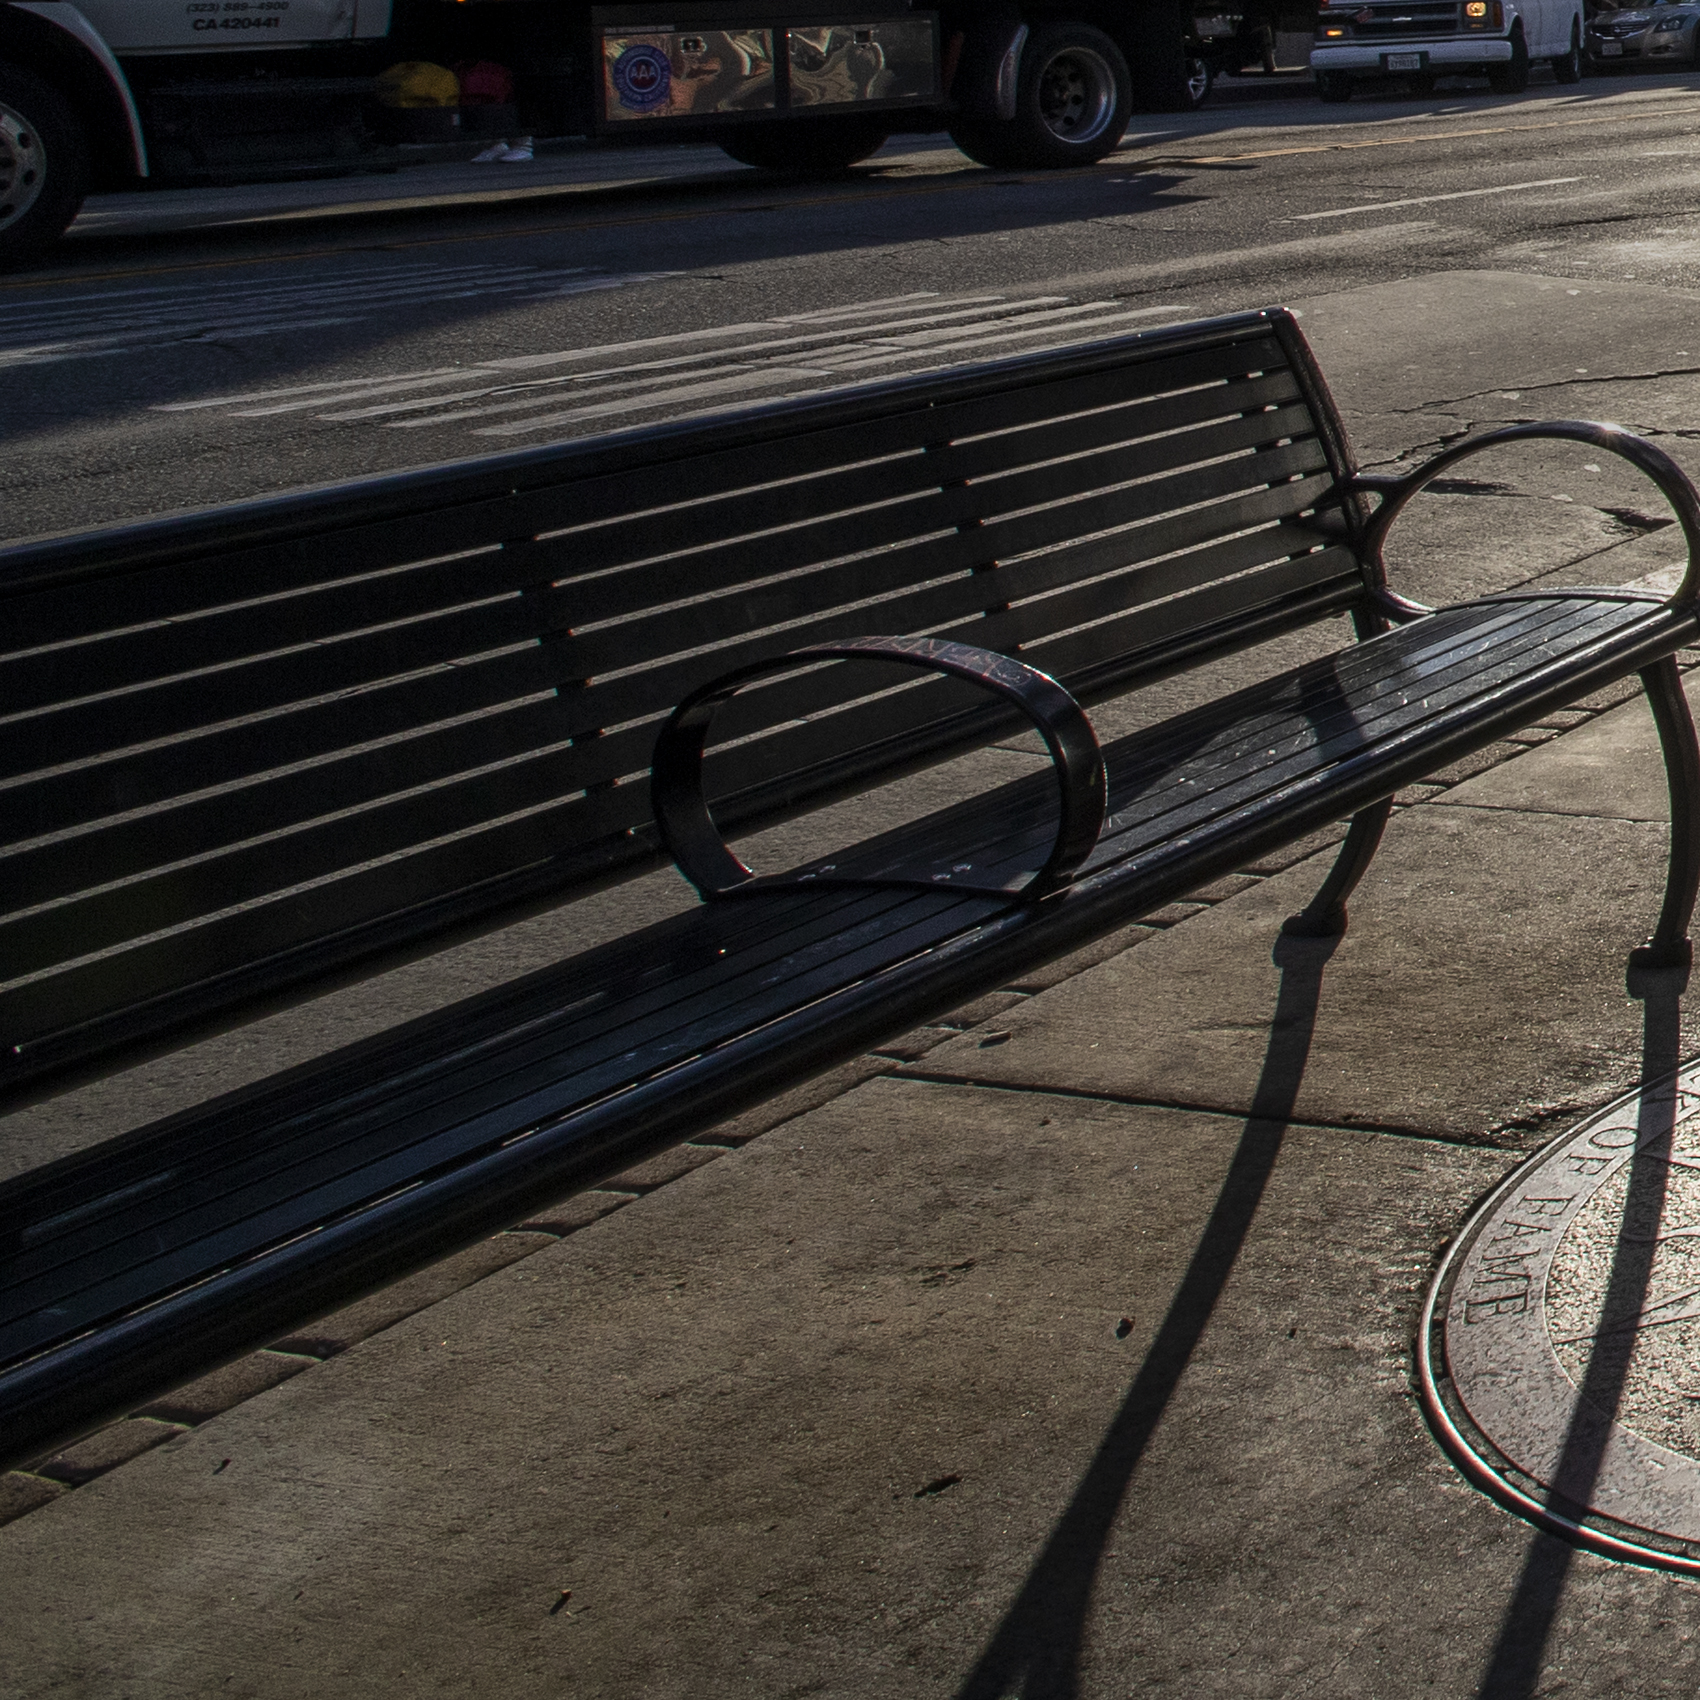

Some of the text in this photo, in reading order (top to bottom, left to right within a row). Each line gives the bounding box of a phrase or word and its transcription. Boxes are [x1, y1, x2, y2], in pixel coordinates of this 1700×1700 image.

[187, 2, 220, 14] (323)
[631, 65, 657, 80] AAA
[1564, 1126, 1640, 1177] OF
[1462, 1194, 1577, 1326] FAME
